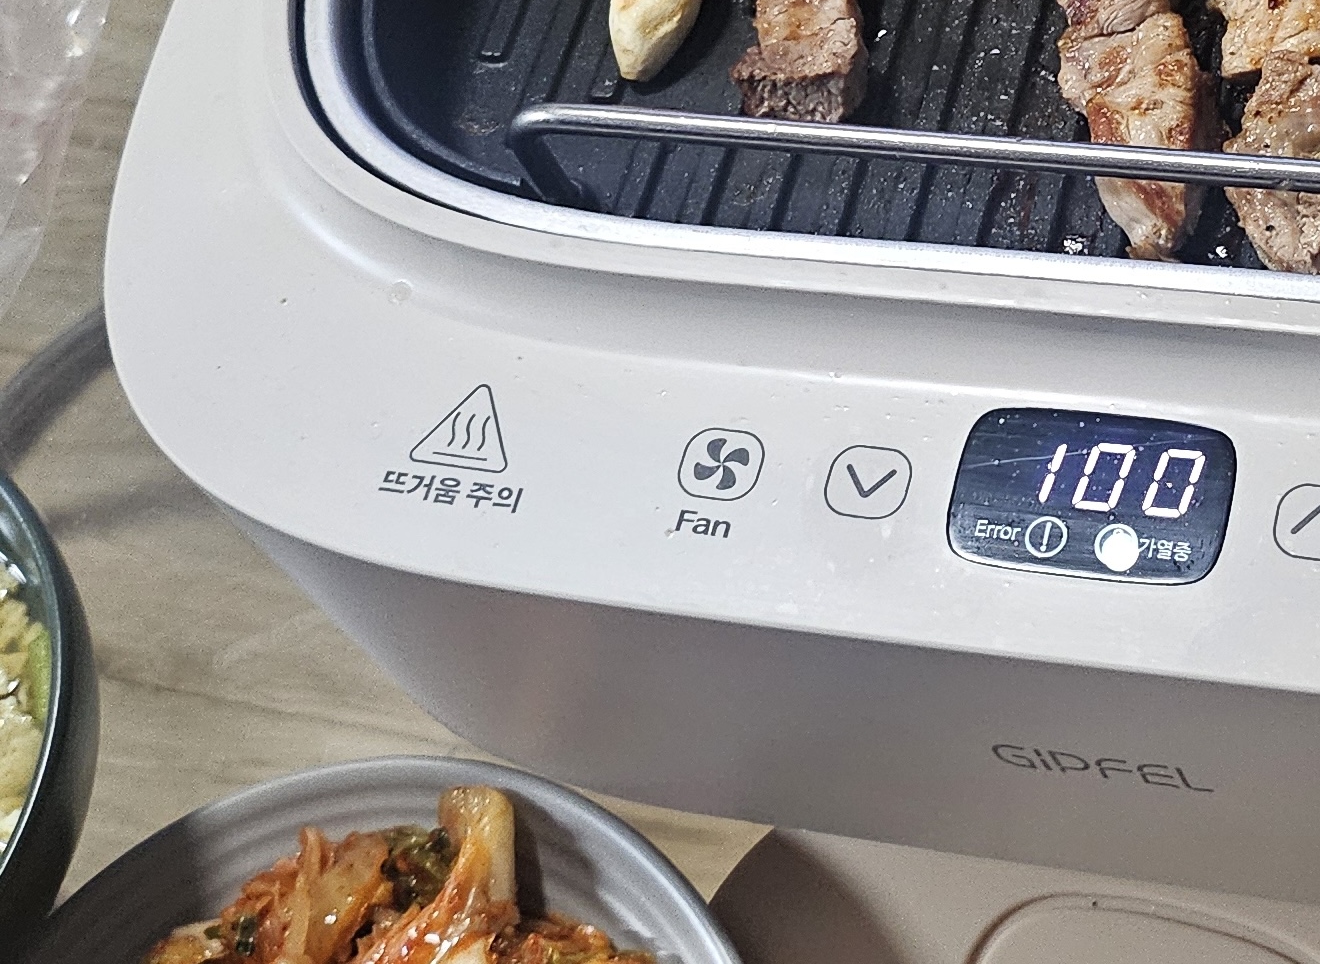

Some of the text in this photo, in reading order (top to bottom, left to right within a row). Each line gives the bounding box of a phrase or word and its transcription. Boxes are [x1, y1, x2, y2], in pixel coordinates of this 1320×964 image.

[378, 469, 523, 513] 뜨거움 주의
[1038, 442, 1206, 519] 100
[674, 509, 732, 539] Fan
[974, 519, 1022, 541] Error
[1138, 537, 1192, 562] 가열중
